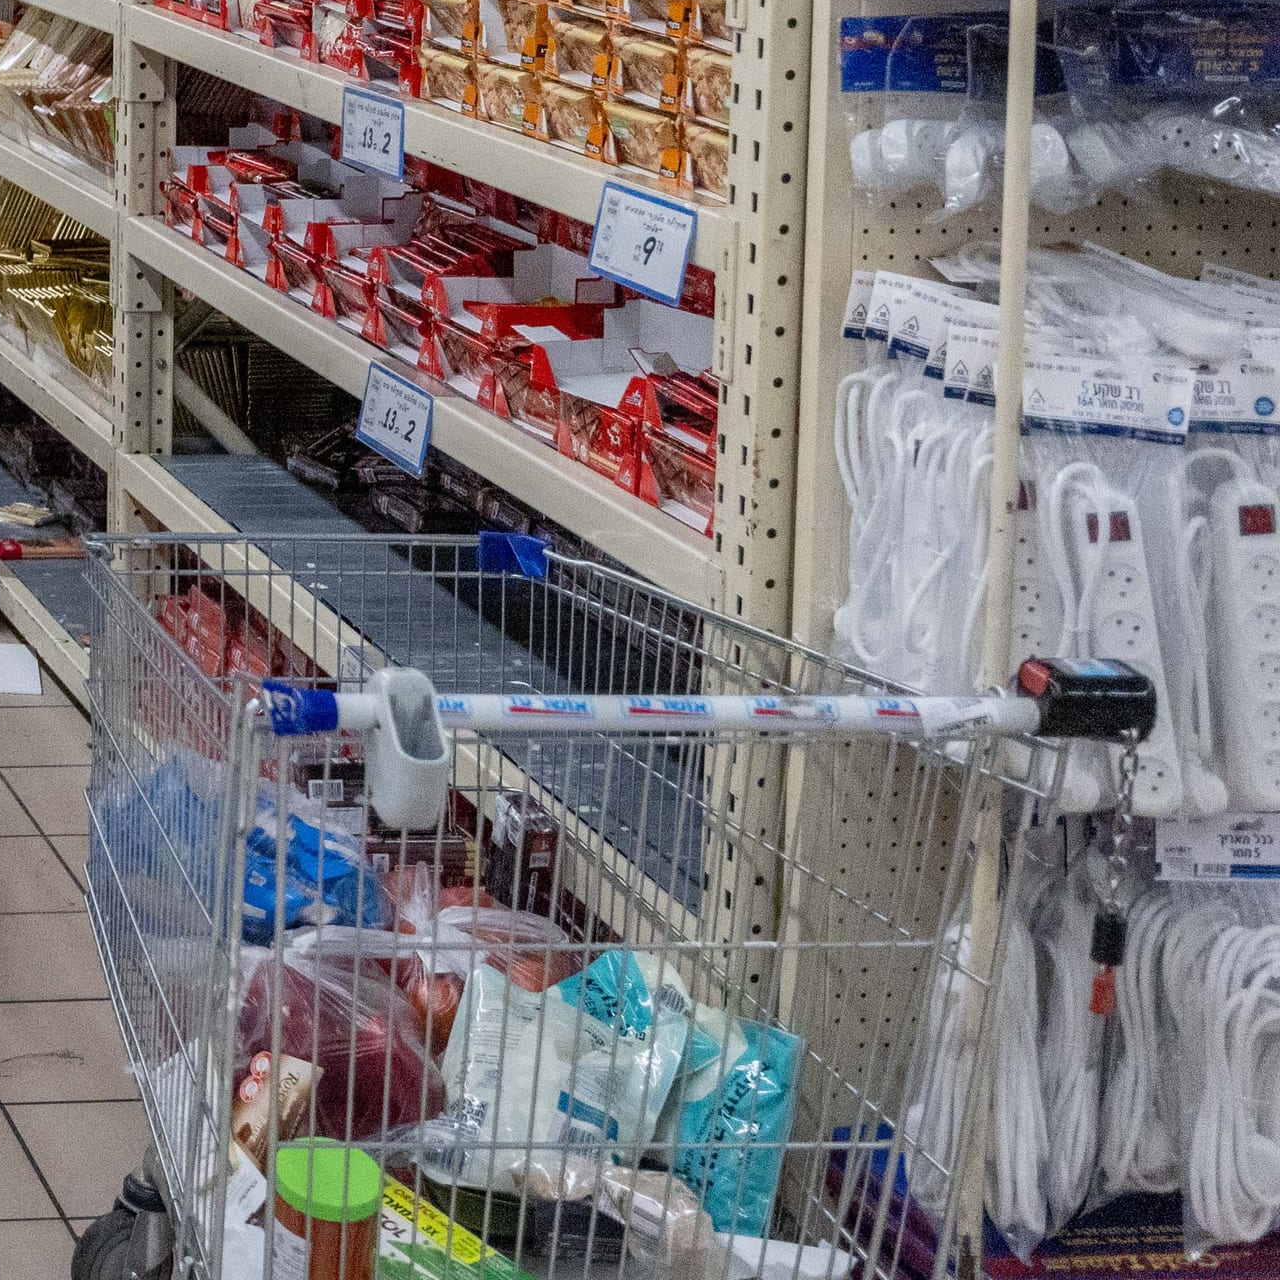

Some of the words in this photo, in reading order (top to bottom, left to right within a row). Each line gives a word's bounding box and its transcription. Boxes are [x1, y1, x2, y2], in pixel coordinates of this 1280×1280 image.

[361, 126, 374, 149] 13
[381, 132, 392, 155] 2
[643, 236, 657, 266] 9
[1080, 380, 1089, 394] 5
[1092, 382, 1122, 399] שקע
[1126, 385, 1141, 401] רב
[1193, 380, 1215, 398] שק
[382, 407, 398, 431] 13
[403, 420, 416, 443] 2
[1254, 847, 1261, 858] 5
